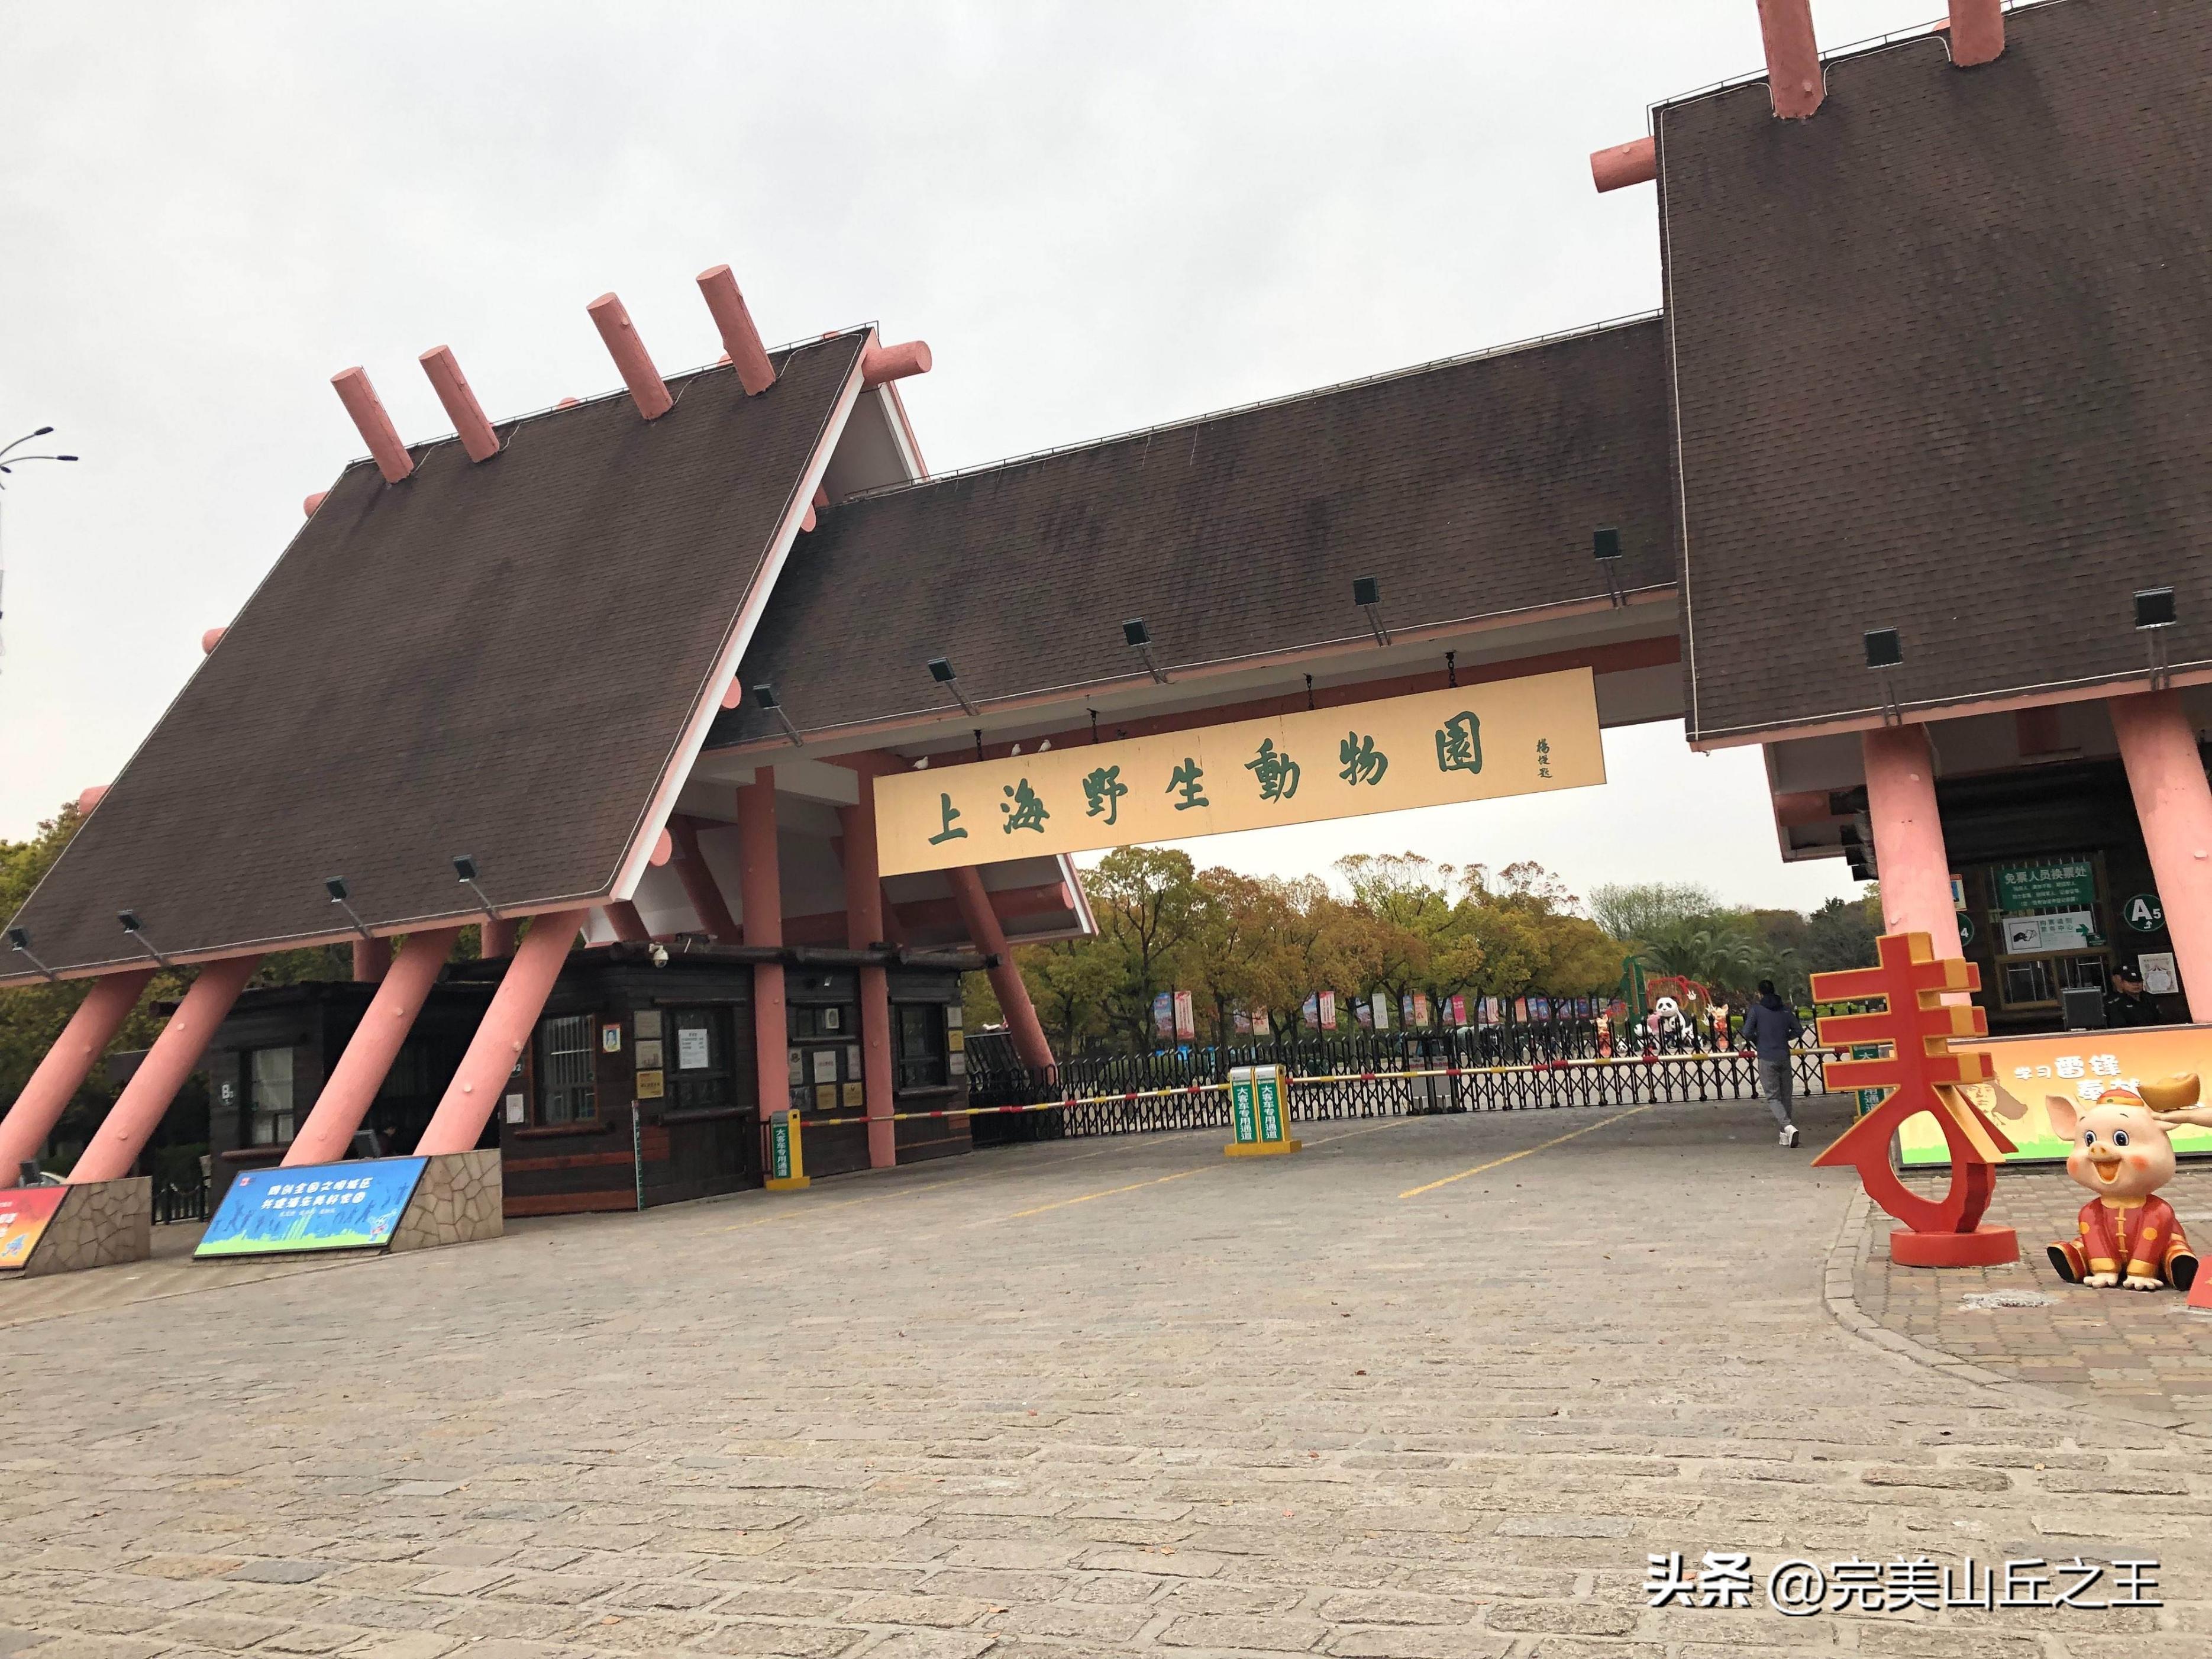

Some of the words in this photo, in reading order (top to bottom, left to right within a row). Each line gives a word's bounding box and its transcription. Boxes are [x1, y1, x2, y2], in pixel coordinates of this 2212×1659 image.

[2004, 866, 2087, 885] 免票人员换票处
[1236, 1087, 1252, 1140] 大客车专用通道
[1261, 1085, 1278, 1139] 大客车专用通道
[776, 1128, 787, 1176] 大客车专用通道
